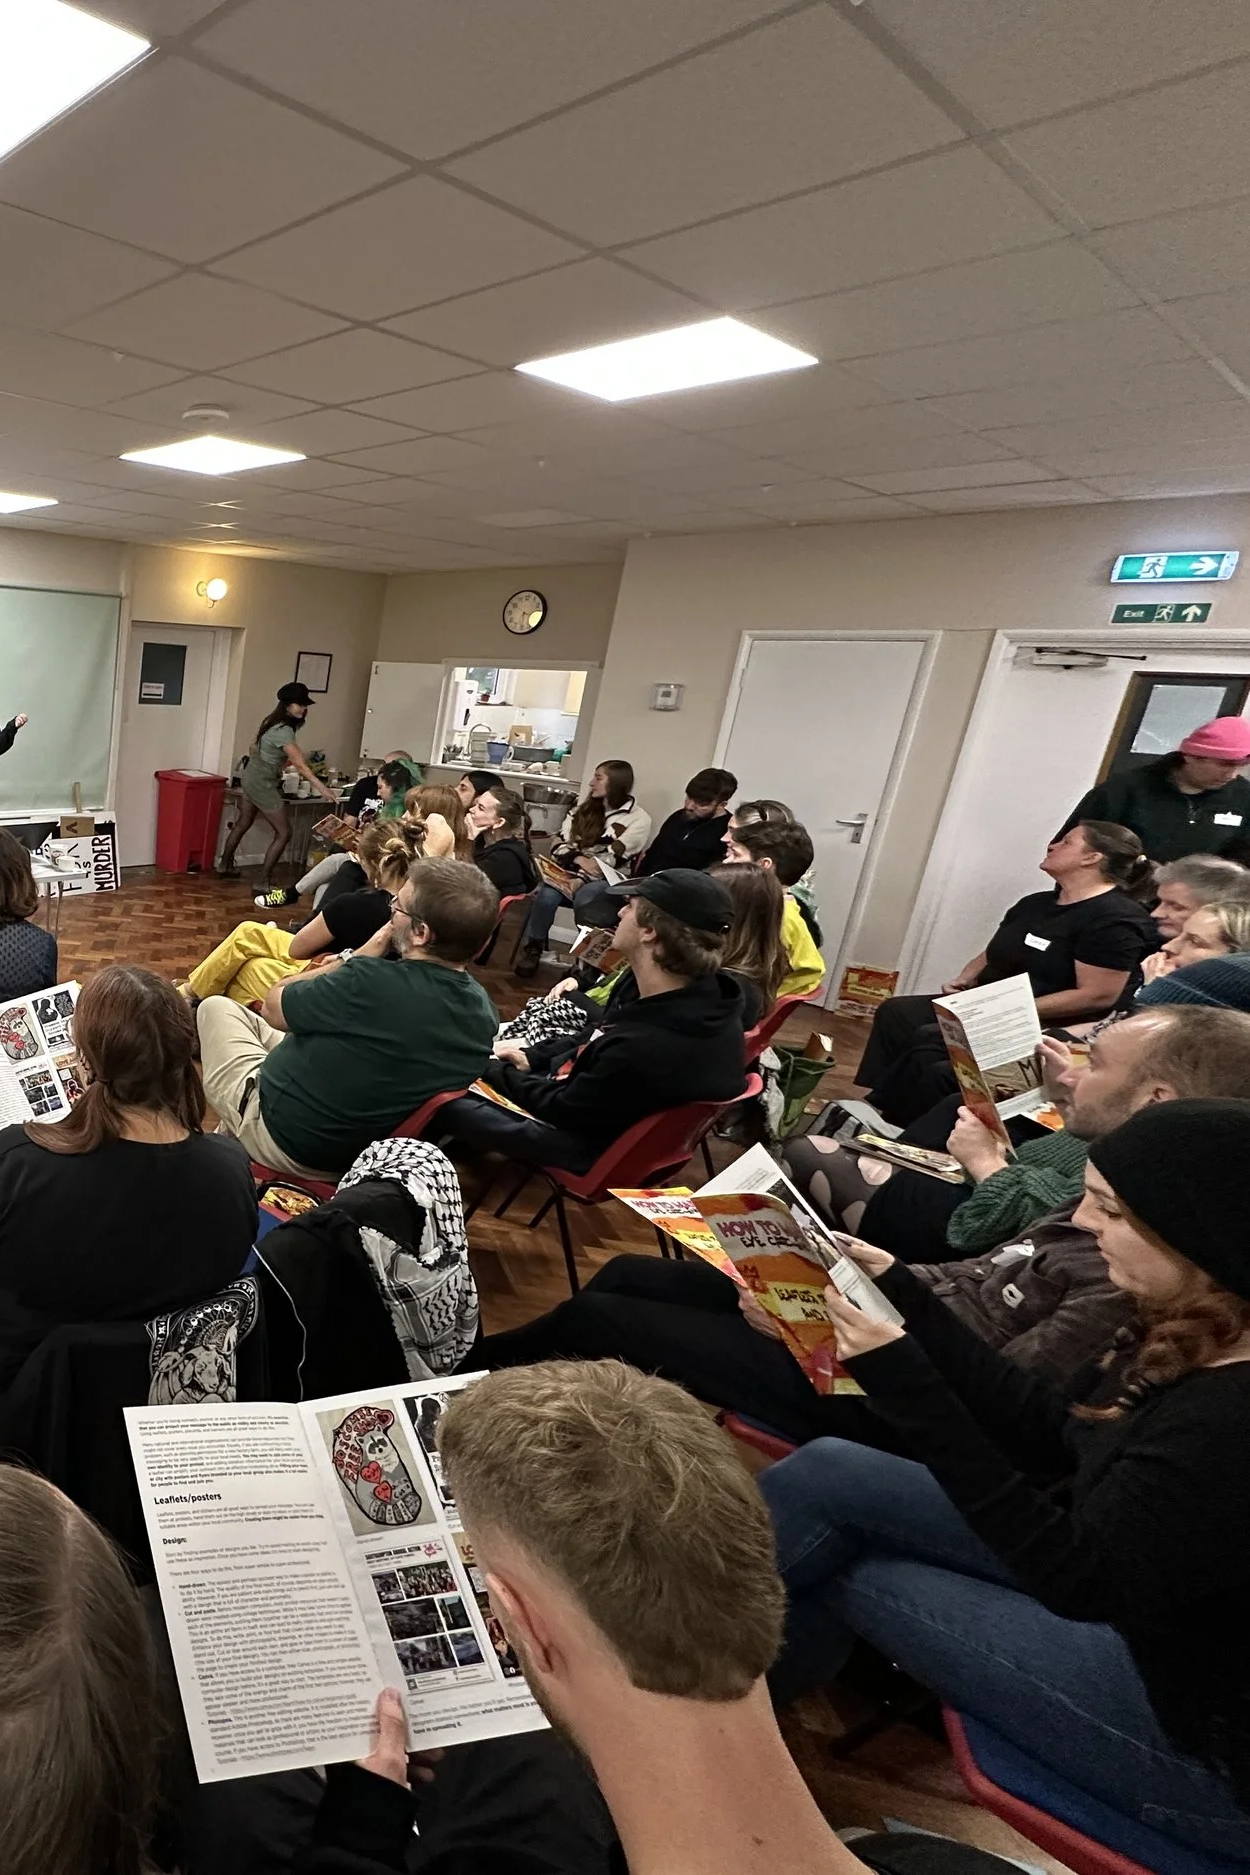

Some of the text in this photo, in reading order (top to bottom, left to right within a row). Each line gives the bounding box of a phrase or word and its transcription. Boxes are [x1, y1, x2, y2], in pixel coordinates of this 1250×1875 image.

[1123, 610, 1145, 618] Exit
[91, 836, 115, 891] MURDER
[716, 1219, 758, 1238] HOW
[756, 1219, 781, 1236] TO
[153, 1493, 222, 1505] Leaflets/posters
